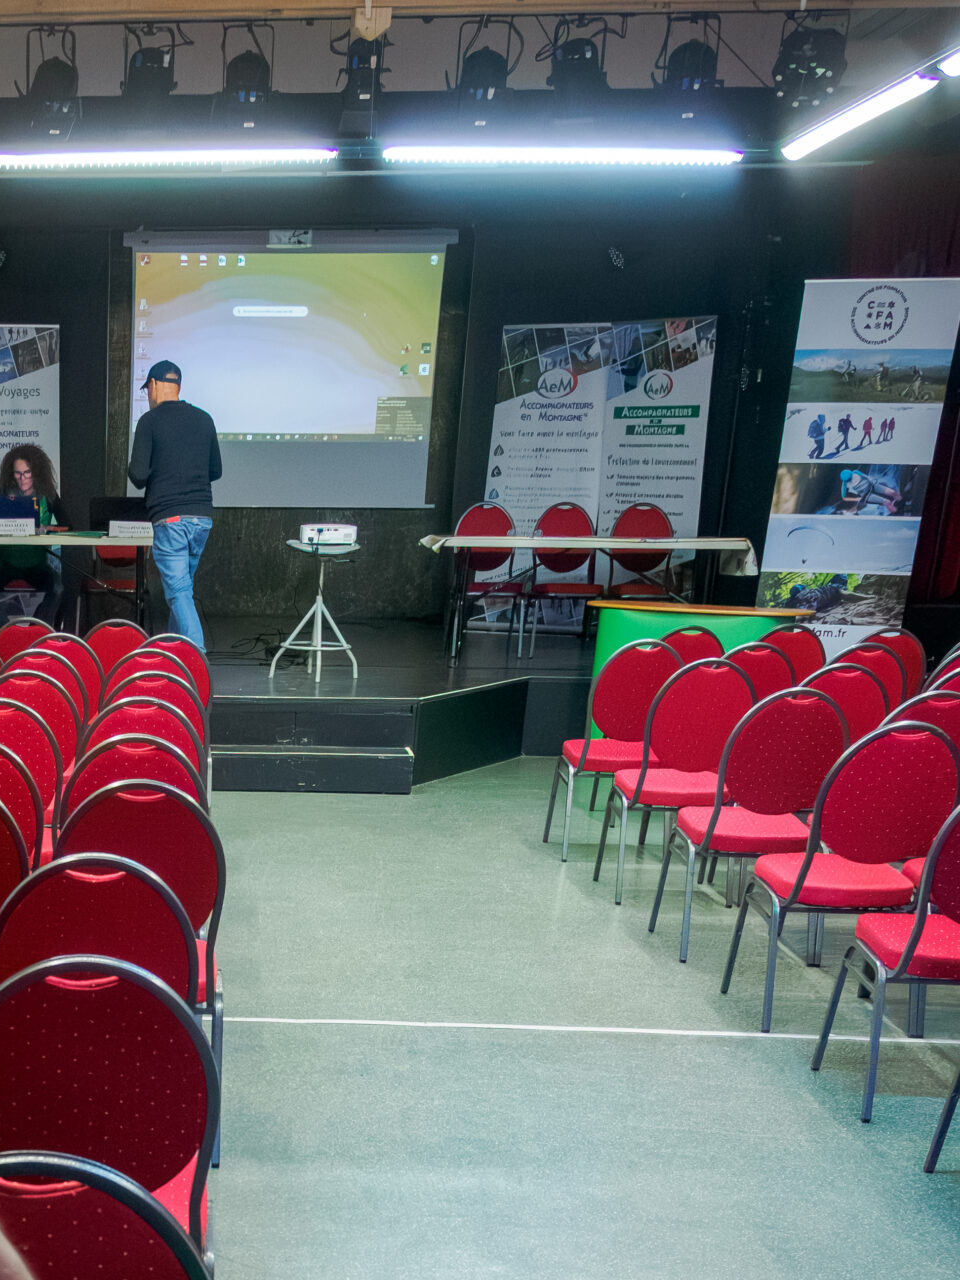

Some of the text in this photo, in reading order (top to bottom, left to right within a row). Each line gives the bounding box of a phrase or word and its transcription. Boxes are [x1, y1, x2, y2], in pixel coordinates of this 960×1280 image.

[539, 378, 572, 393] AeM
[647, 381, 669, 395] AeM
[520, 413, 531, 421] en
[634, 424, 677, 435] MONTAGNE
